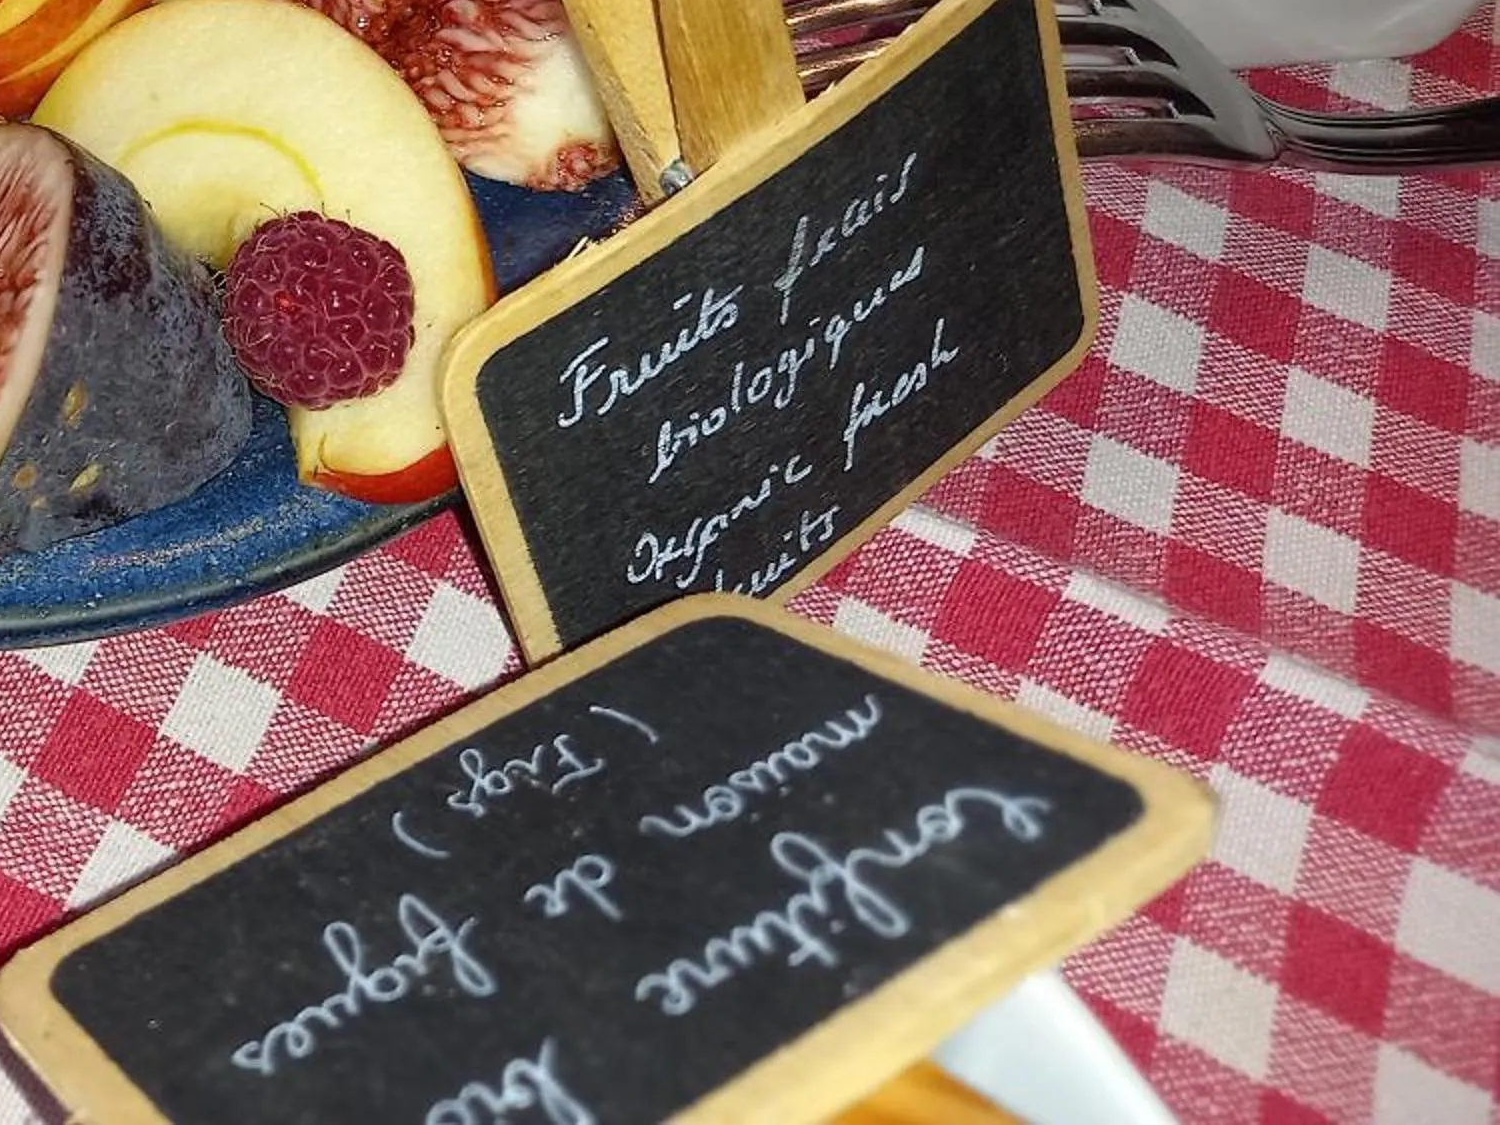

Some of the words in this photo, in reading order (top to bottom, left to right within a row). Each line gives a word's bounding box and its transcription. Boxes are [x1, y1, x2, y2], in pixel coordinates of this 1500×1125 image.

[557, 284, 744, 430] Fruits
[773, 151, 919, 326] frais
[647, 245, 926, 485] biologiques
[626, 453, 815, 591] Organic
[841, 316, 961, 473] fresh
[637, 692, 886, 841] maison
[228, 892, 500, 1079] figues
[521, 852, 625, 925] de
[634, 784, 1053, 1020] Confiture
